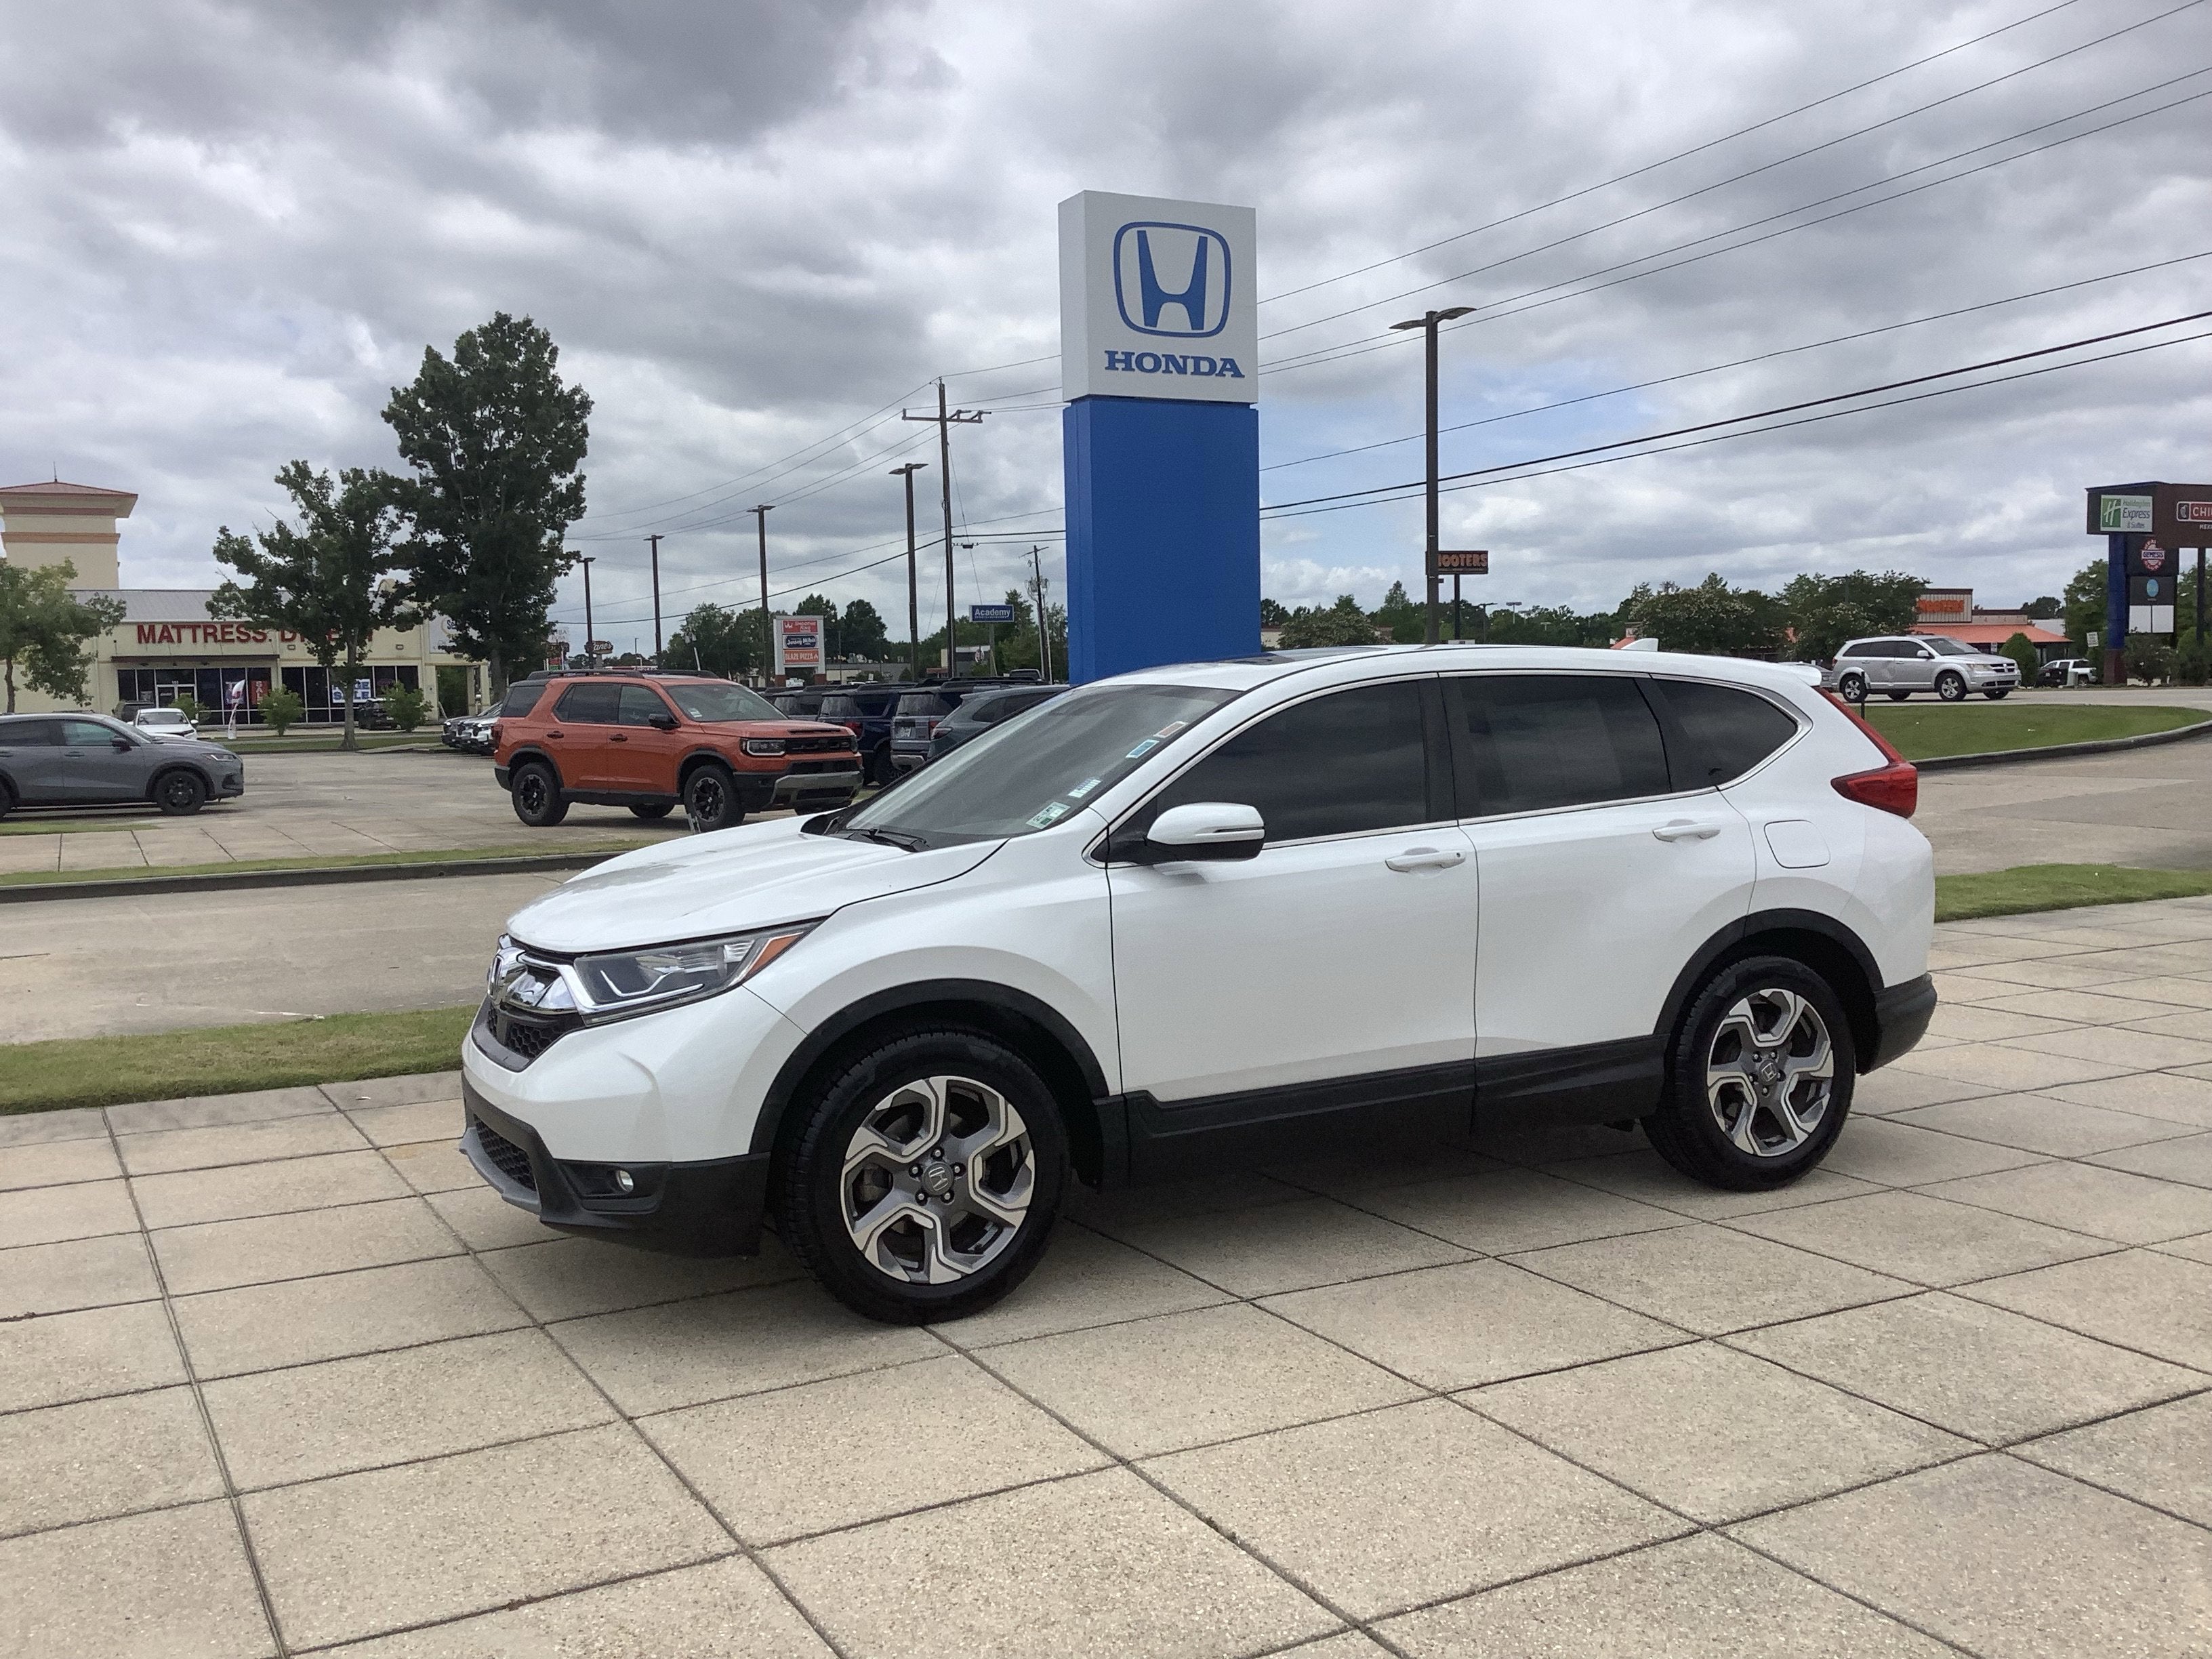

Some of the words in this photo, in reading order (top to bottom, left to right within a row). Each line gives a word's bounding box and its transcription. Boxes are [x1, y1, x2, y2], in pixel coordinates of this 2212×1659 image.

[1104, 350, 1245, 378] HONDA
[2123, 507, 2151, 520] Express
[975, 608, 1010, 617] Academy
[137, 623, 267, 644] MATTRESS
[333, 691, 369, 700] SLE
